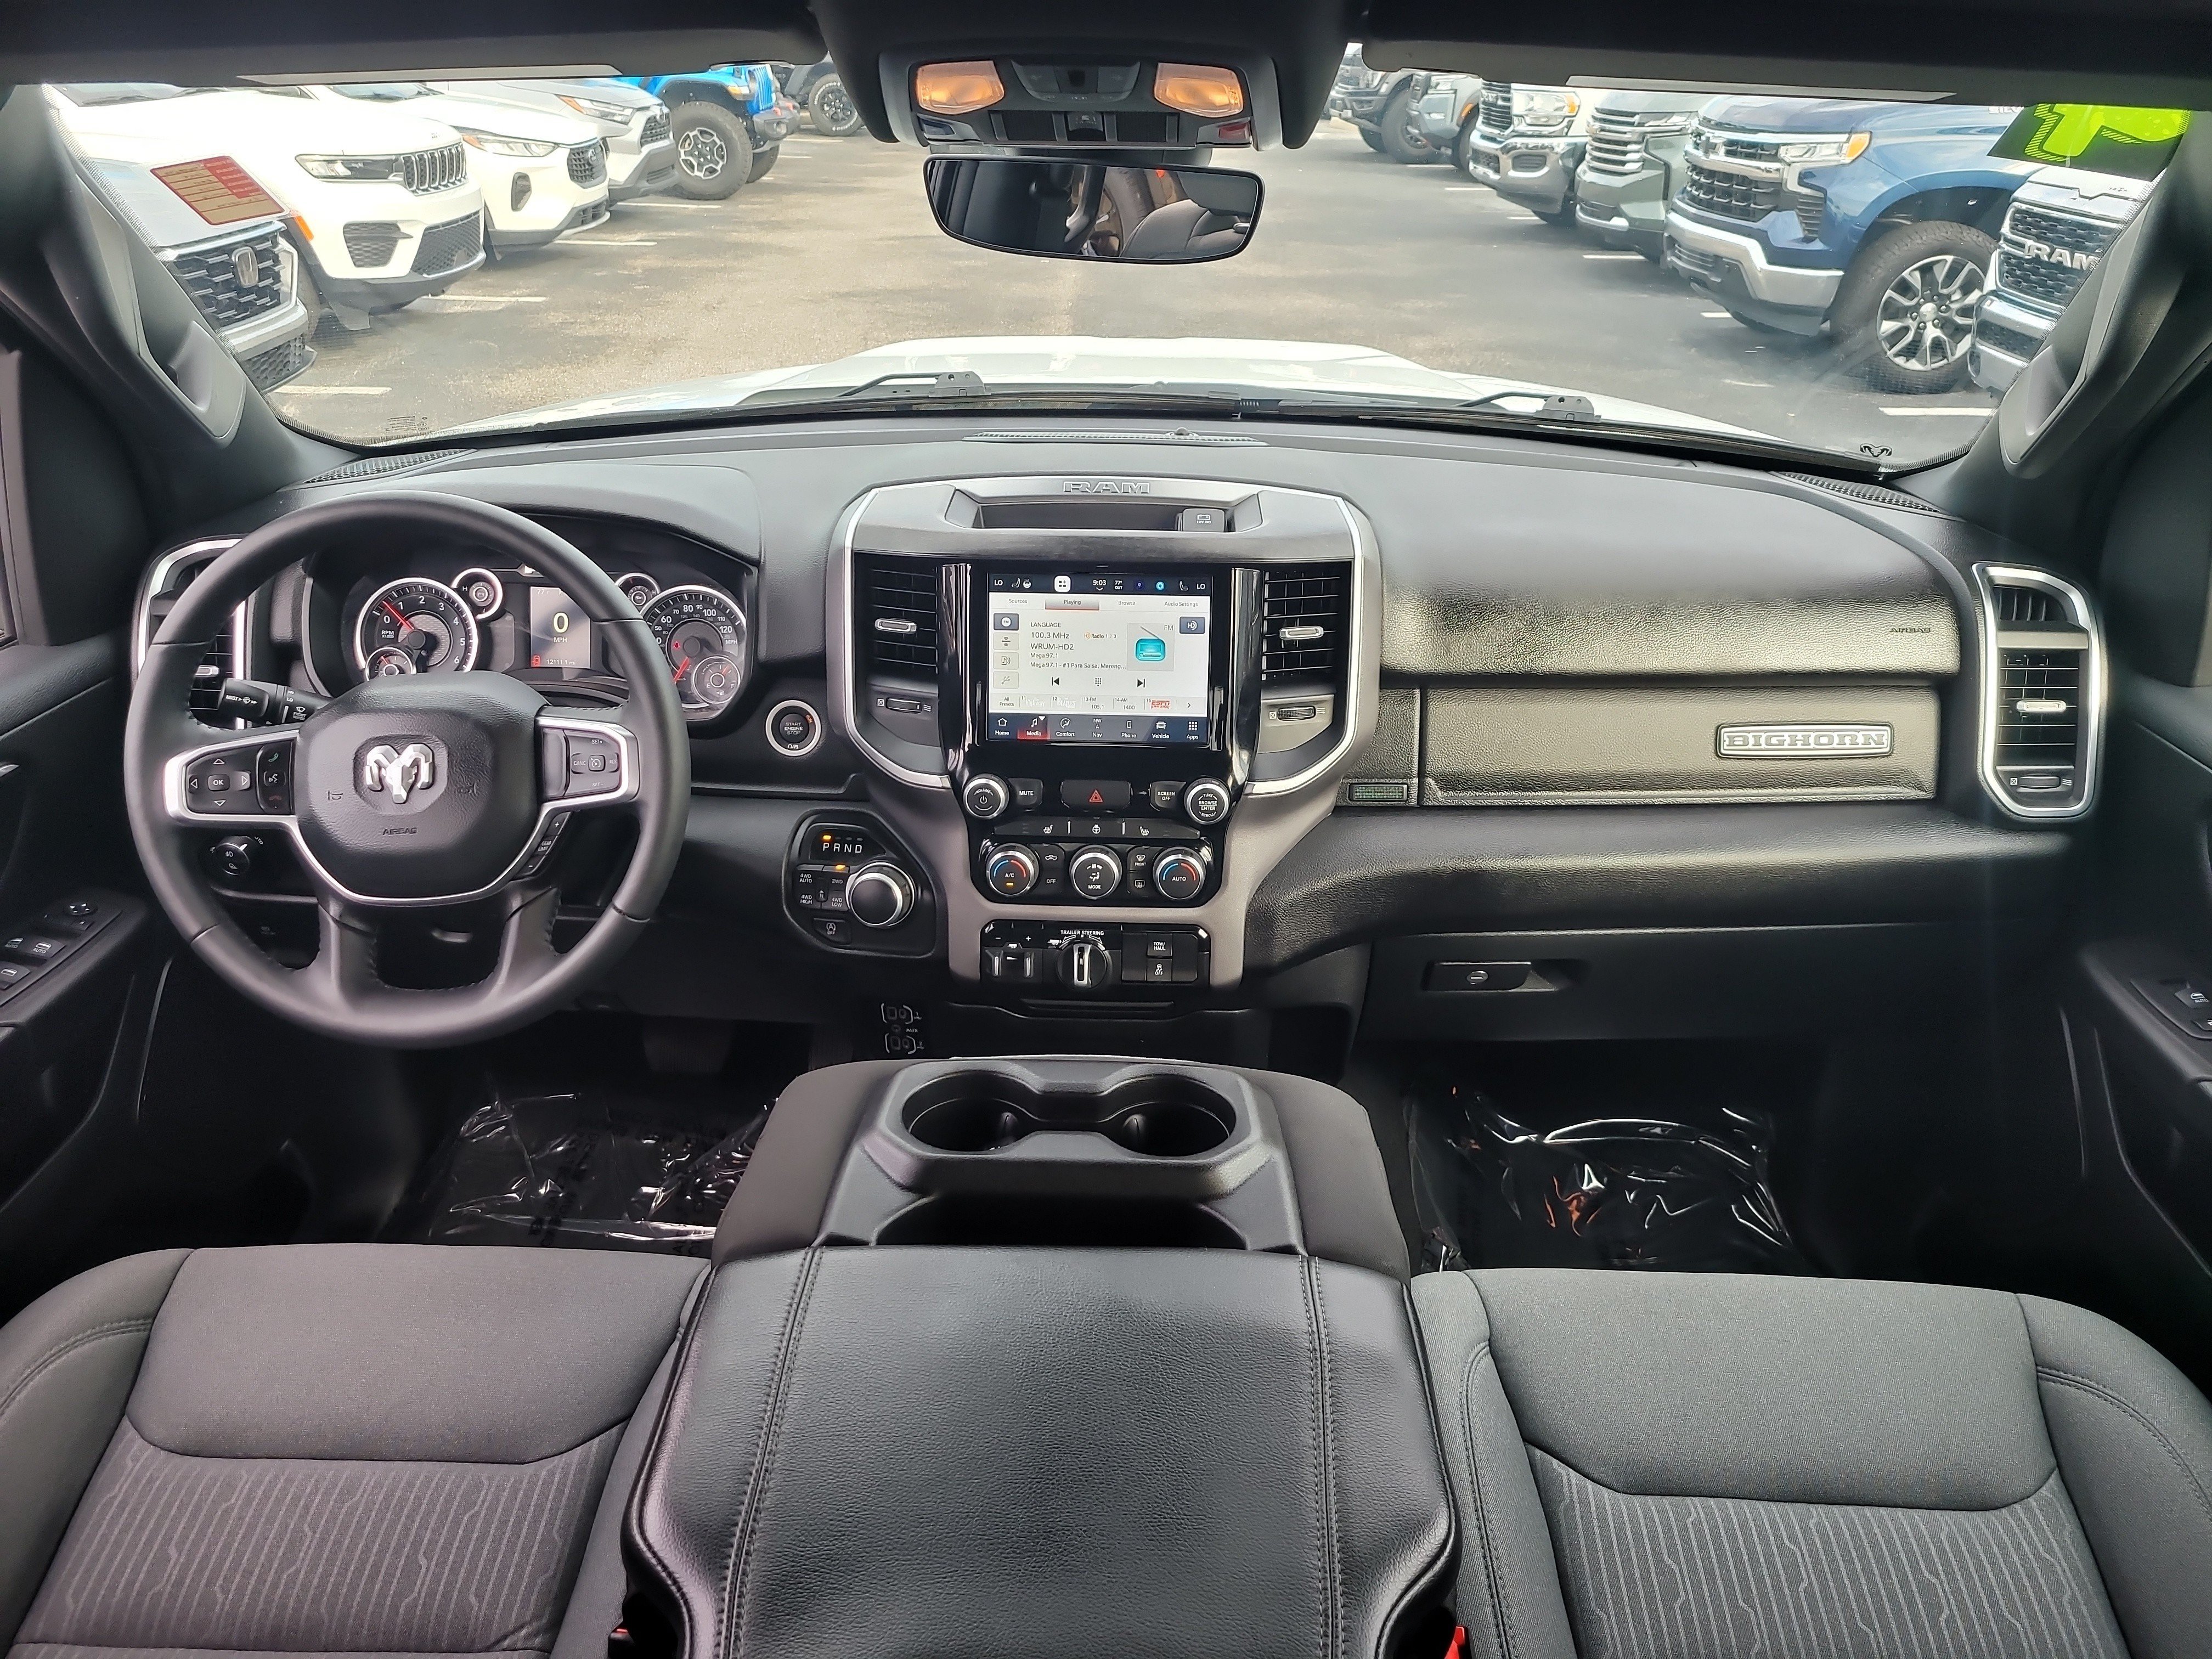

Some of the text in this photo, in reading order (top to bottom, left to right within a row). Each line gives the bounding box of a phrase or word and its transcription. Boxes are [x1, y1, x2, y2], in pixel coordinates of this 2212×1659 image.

[1063, 481, 1149, 493] RAM
[554, 612, 569, 633] 0
[460, 638, 465, 646] 5
[1726, 734, 1885, 747] BIGHORN
[823, 843, 862, 853] P R N D
